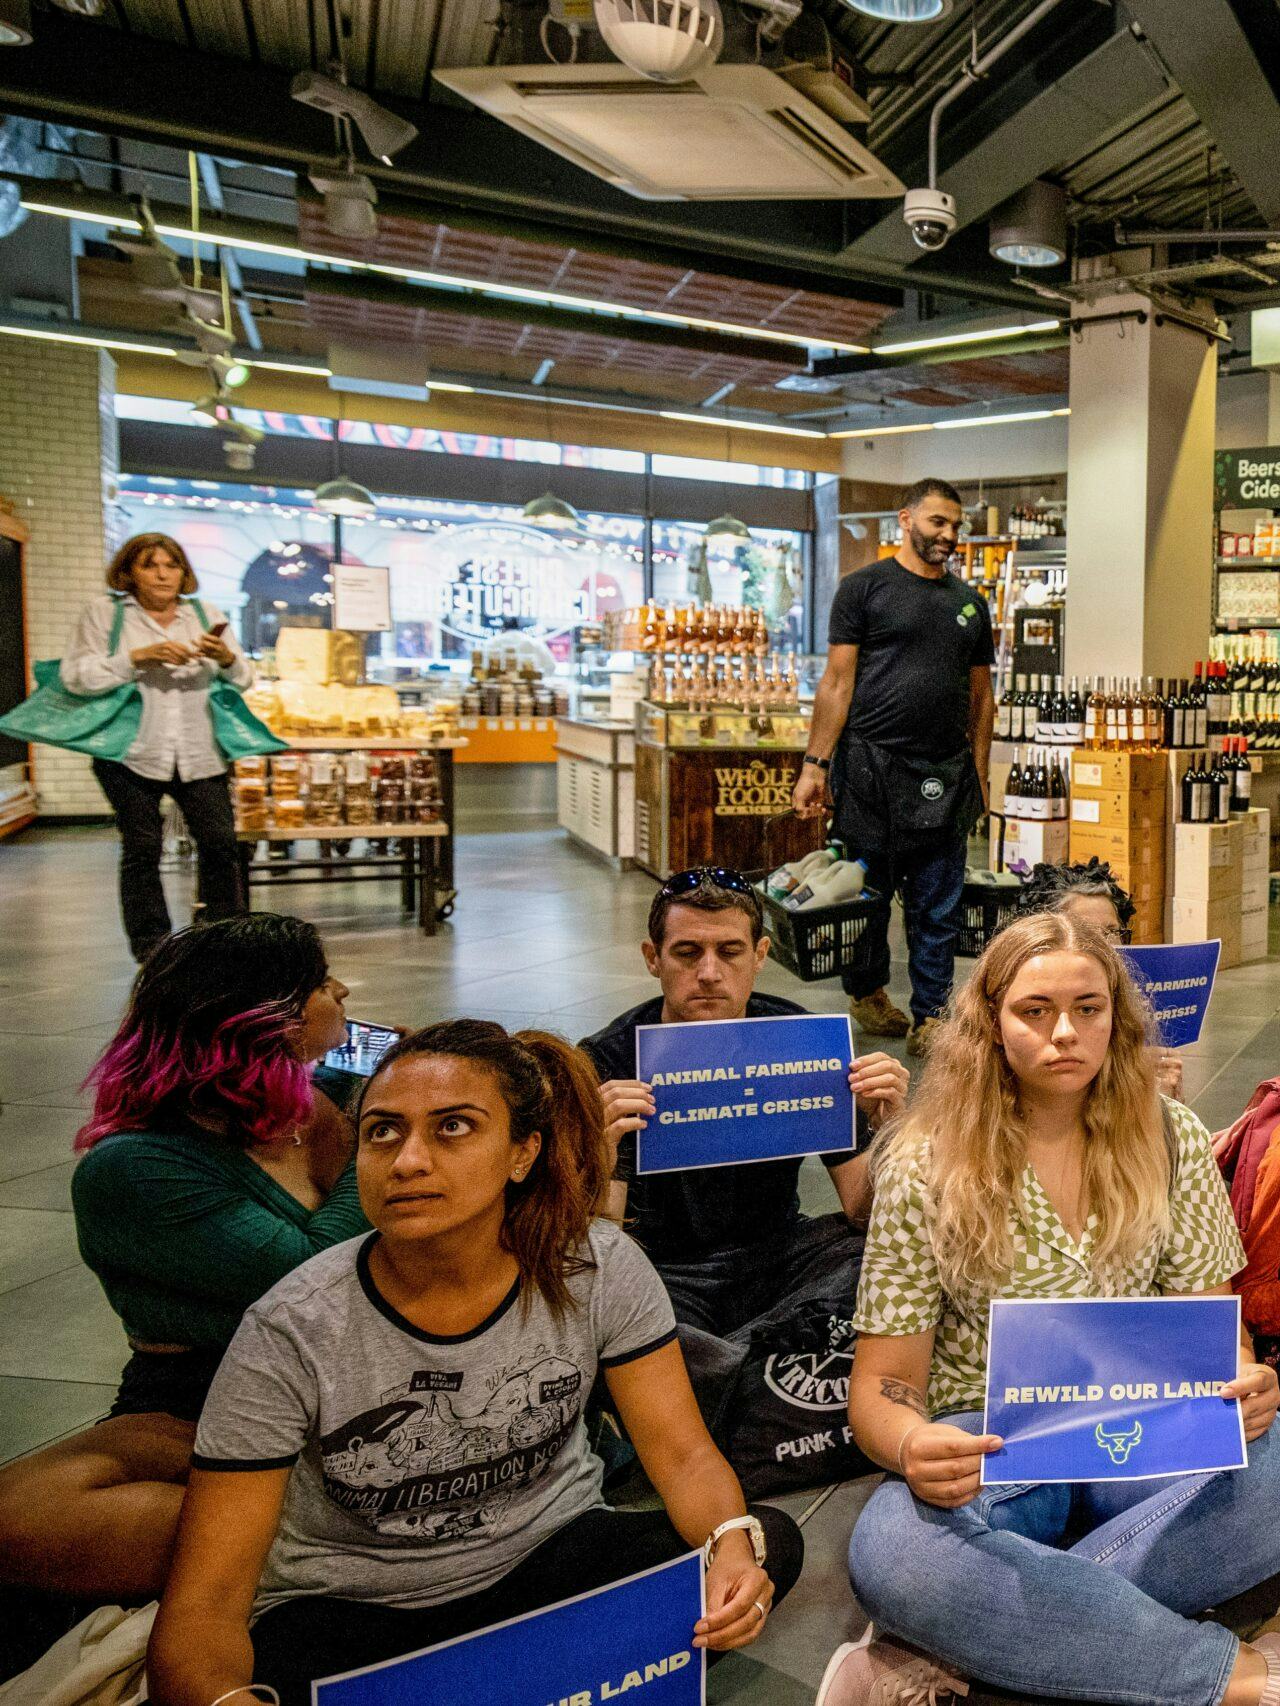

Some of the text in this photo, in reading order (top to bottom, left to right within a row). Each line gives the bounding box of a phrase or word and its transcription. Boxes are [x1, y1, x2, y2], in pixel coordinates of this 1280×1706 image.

[714, 765, 795, 787] WHOLE
[718, 787, 791, 806] FOODS
[1145, 976, 1208, 993] FARMING
[1153, 1004, 1198, 1021] CRISIS
[650, 1058, 843, 1087] ANIMAL FARMING
[744, 1088, 754, 1096] =
[659, 1096, 834, 1125] CLIMATE CRISIS
[543, 1381, 565, 1391] DYING
[778, 1363, 851, 1404] RECO
[1004, 1381, 1227, 1404] REWILD OUR LAND
[775, 1431, 836, 1462] PUNK
[324, 1482, 389, 1510] ANIMAL
[394, 1455, 526, 1509] LIBERATION
[545, 1650, 692, 1706] UR LAND
